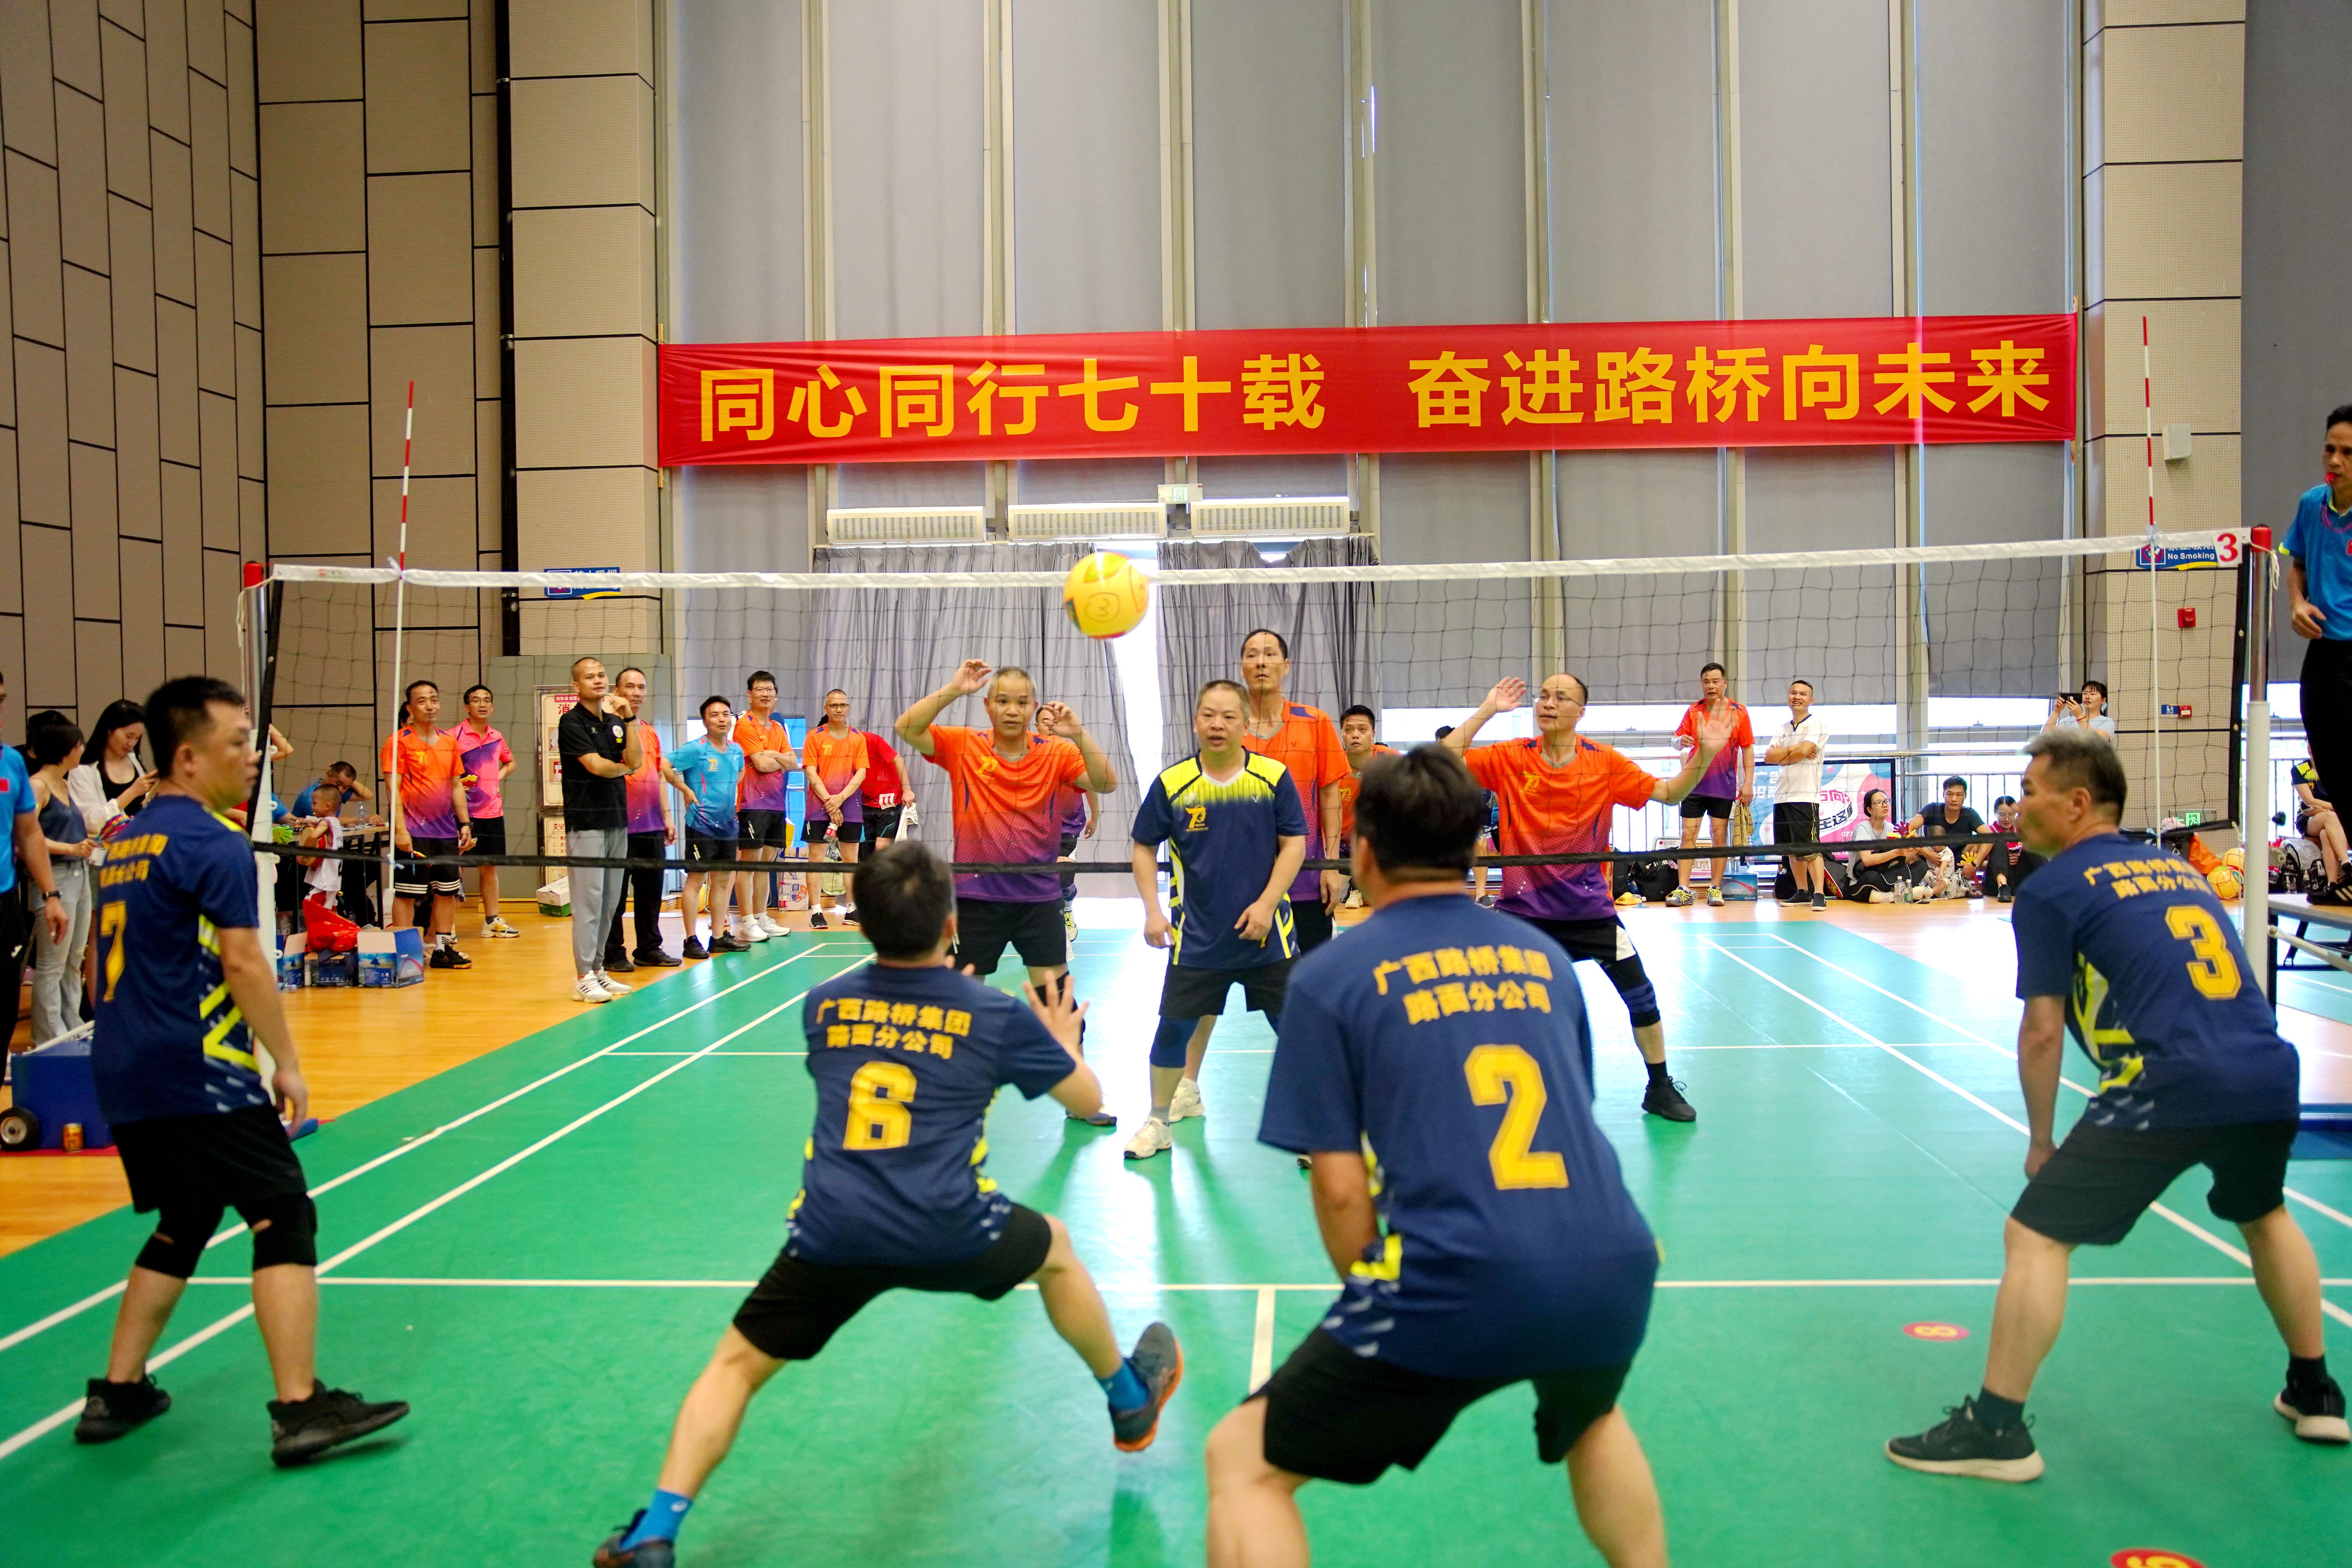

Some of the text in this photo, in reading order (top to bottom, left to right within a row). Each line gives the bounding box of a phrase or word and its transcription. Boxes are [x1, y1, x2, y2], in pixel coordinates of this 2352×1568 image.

[701, 353, 1325, 442] 同心同行七十载
[1407, 340, 2050, 428] 奋进路桥向未来
[2217, 533, 2238, 562] 3
[882, 796, 891, 806] 11
[100, 901, 127, 1003] 7
[1373, 944, 1553, 996] 广西路桥集团
[2164, 905, 2241, 1000] 3
[1402, 979, 1551, 1025] 路面分公司
[843, 1061, 918, 1151] 6
[1463, 1044, 1569, 1190] 2
